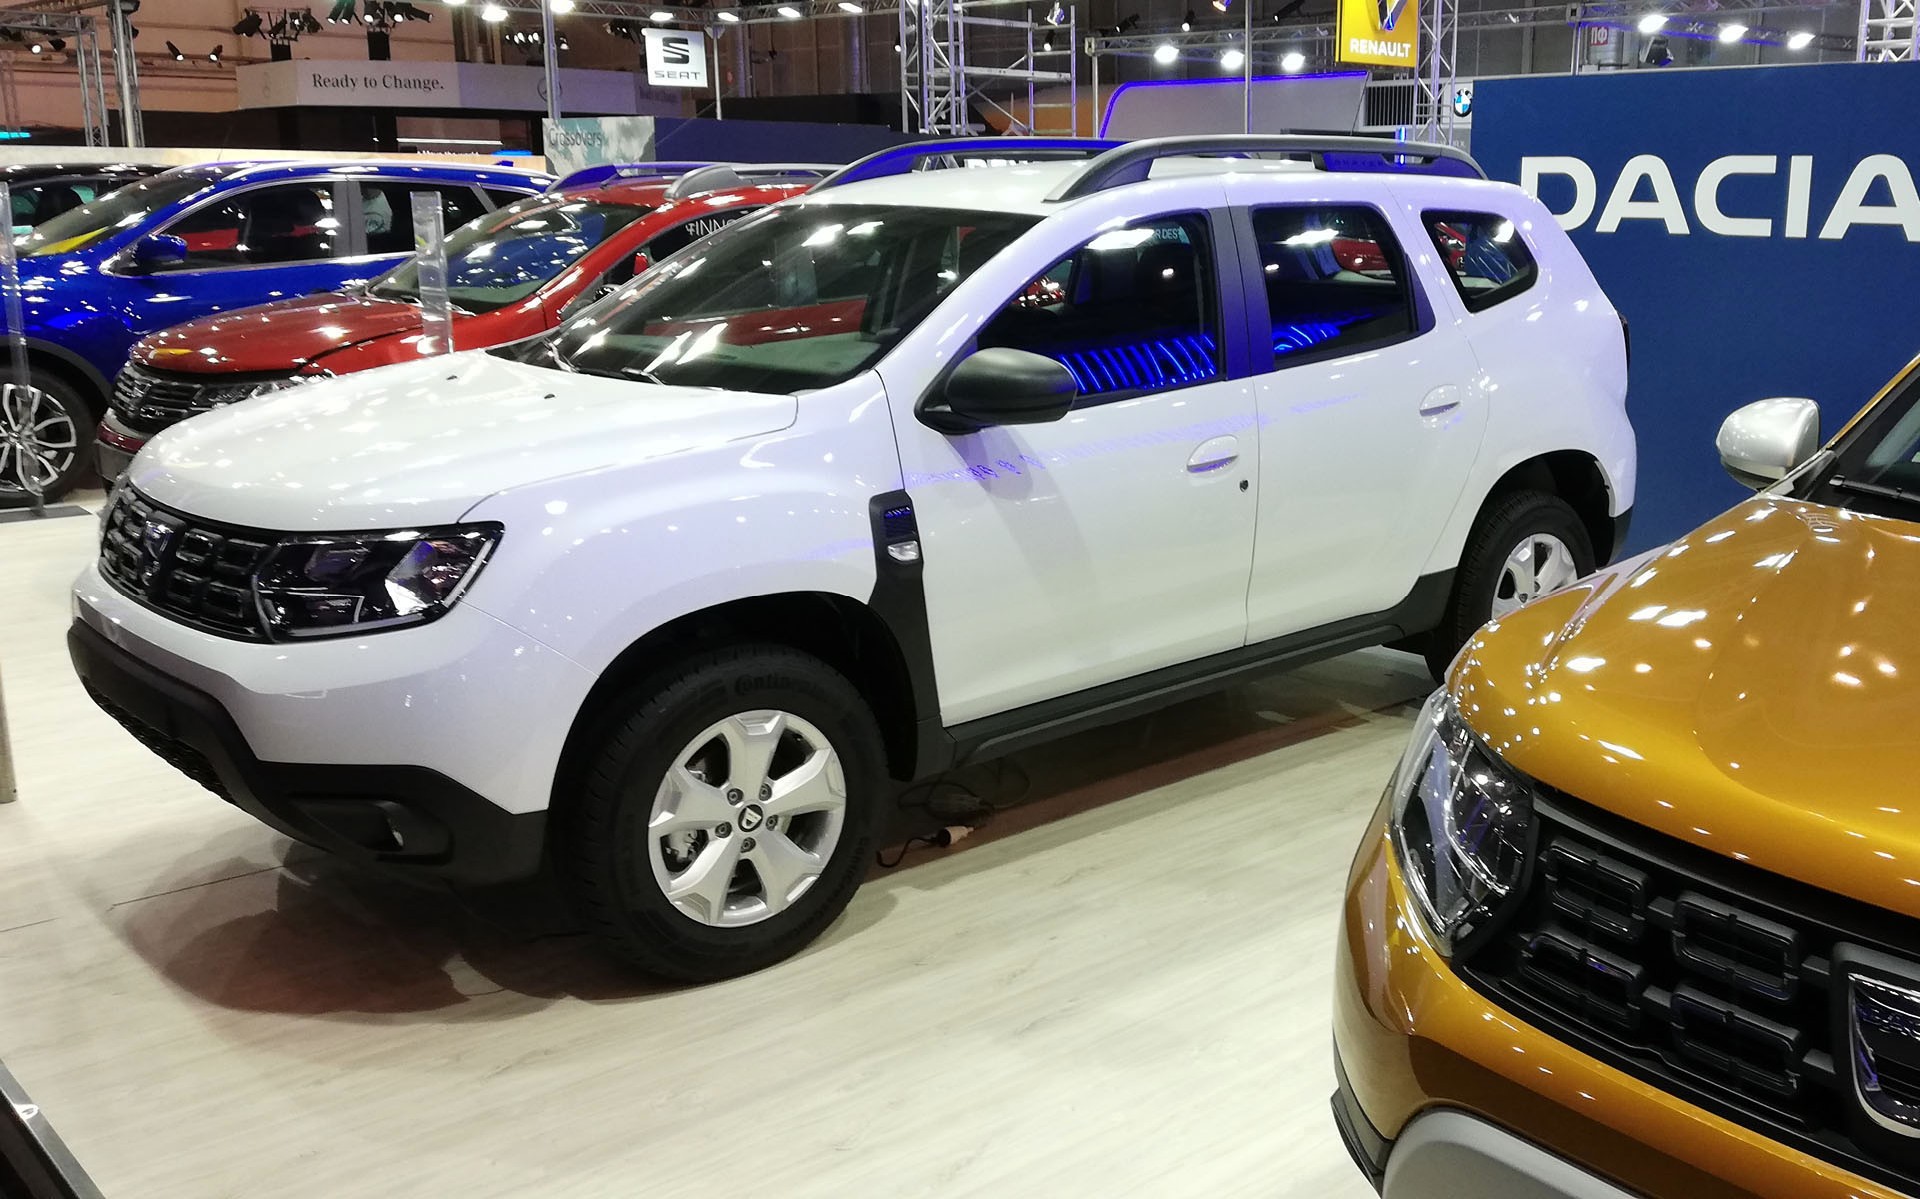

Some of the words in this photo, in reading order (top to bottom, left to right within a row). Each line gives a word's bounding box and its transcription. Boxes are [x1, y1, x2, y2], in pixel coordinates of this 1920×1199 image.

[1350, 38, 1411, 58] RENAULT
[312, 72, 358, 92] Ready
[363, 75, 378, 89] to
[382, 73, 446, 93] Change.
[654, 70, 701, 81] SEAT
[549, 127, 603, 147] Crossovers
[1520, 153, 1920, 243] DACIA
